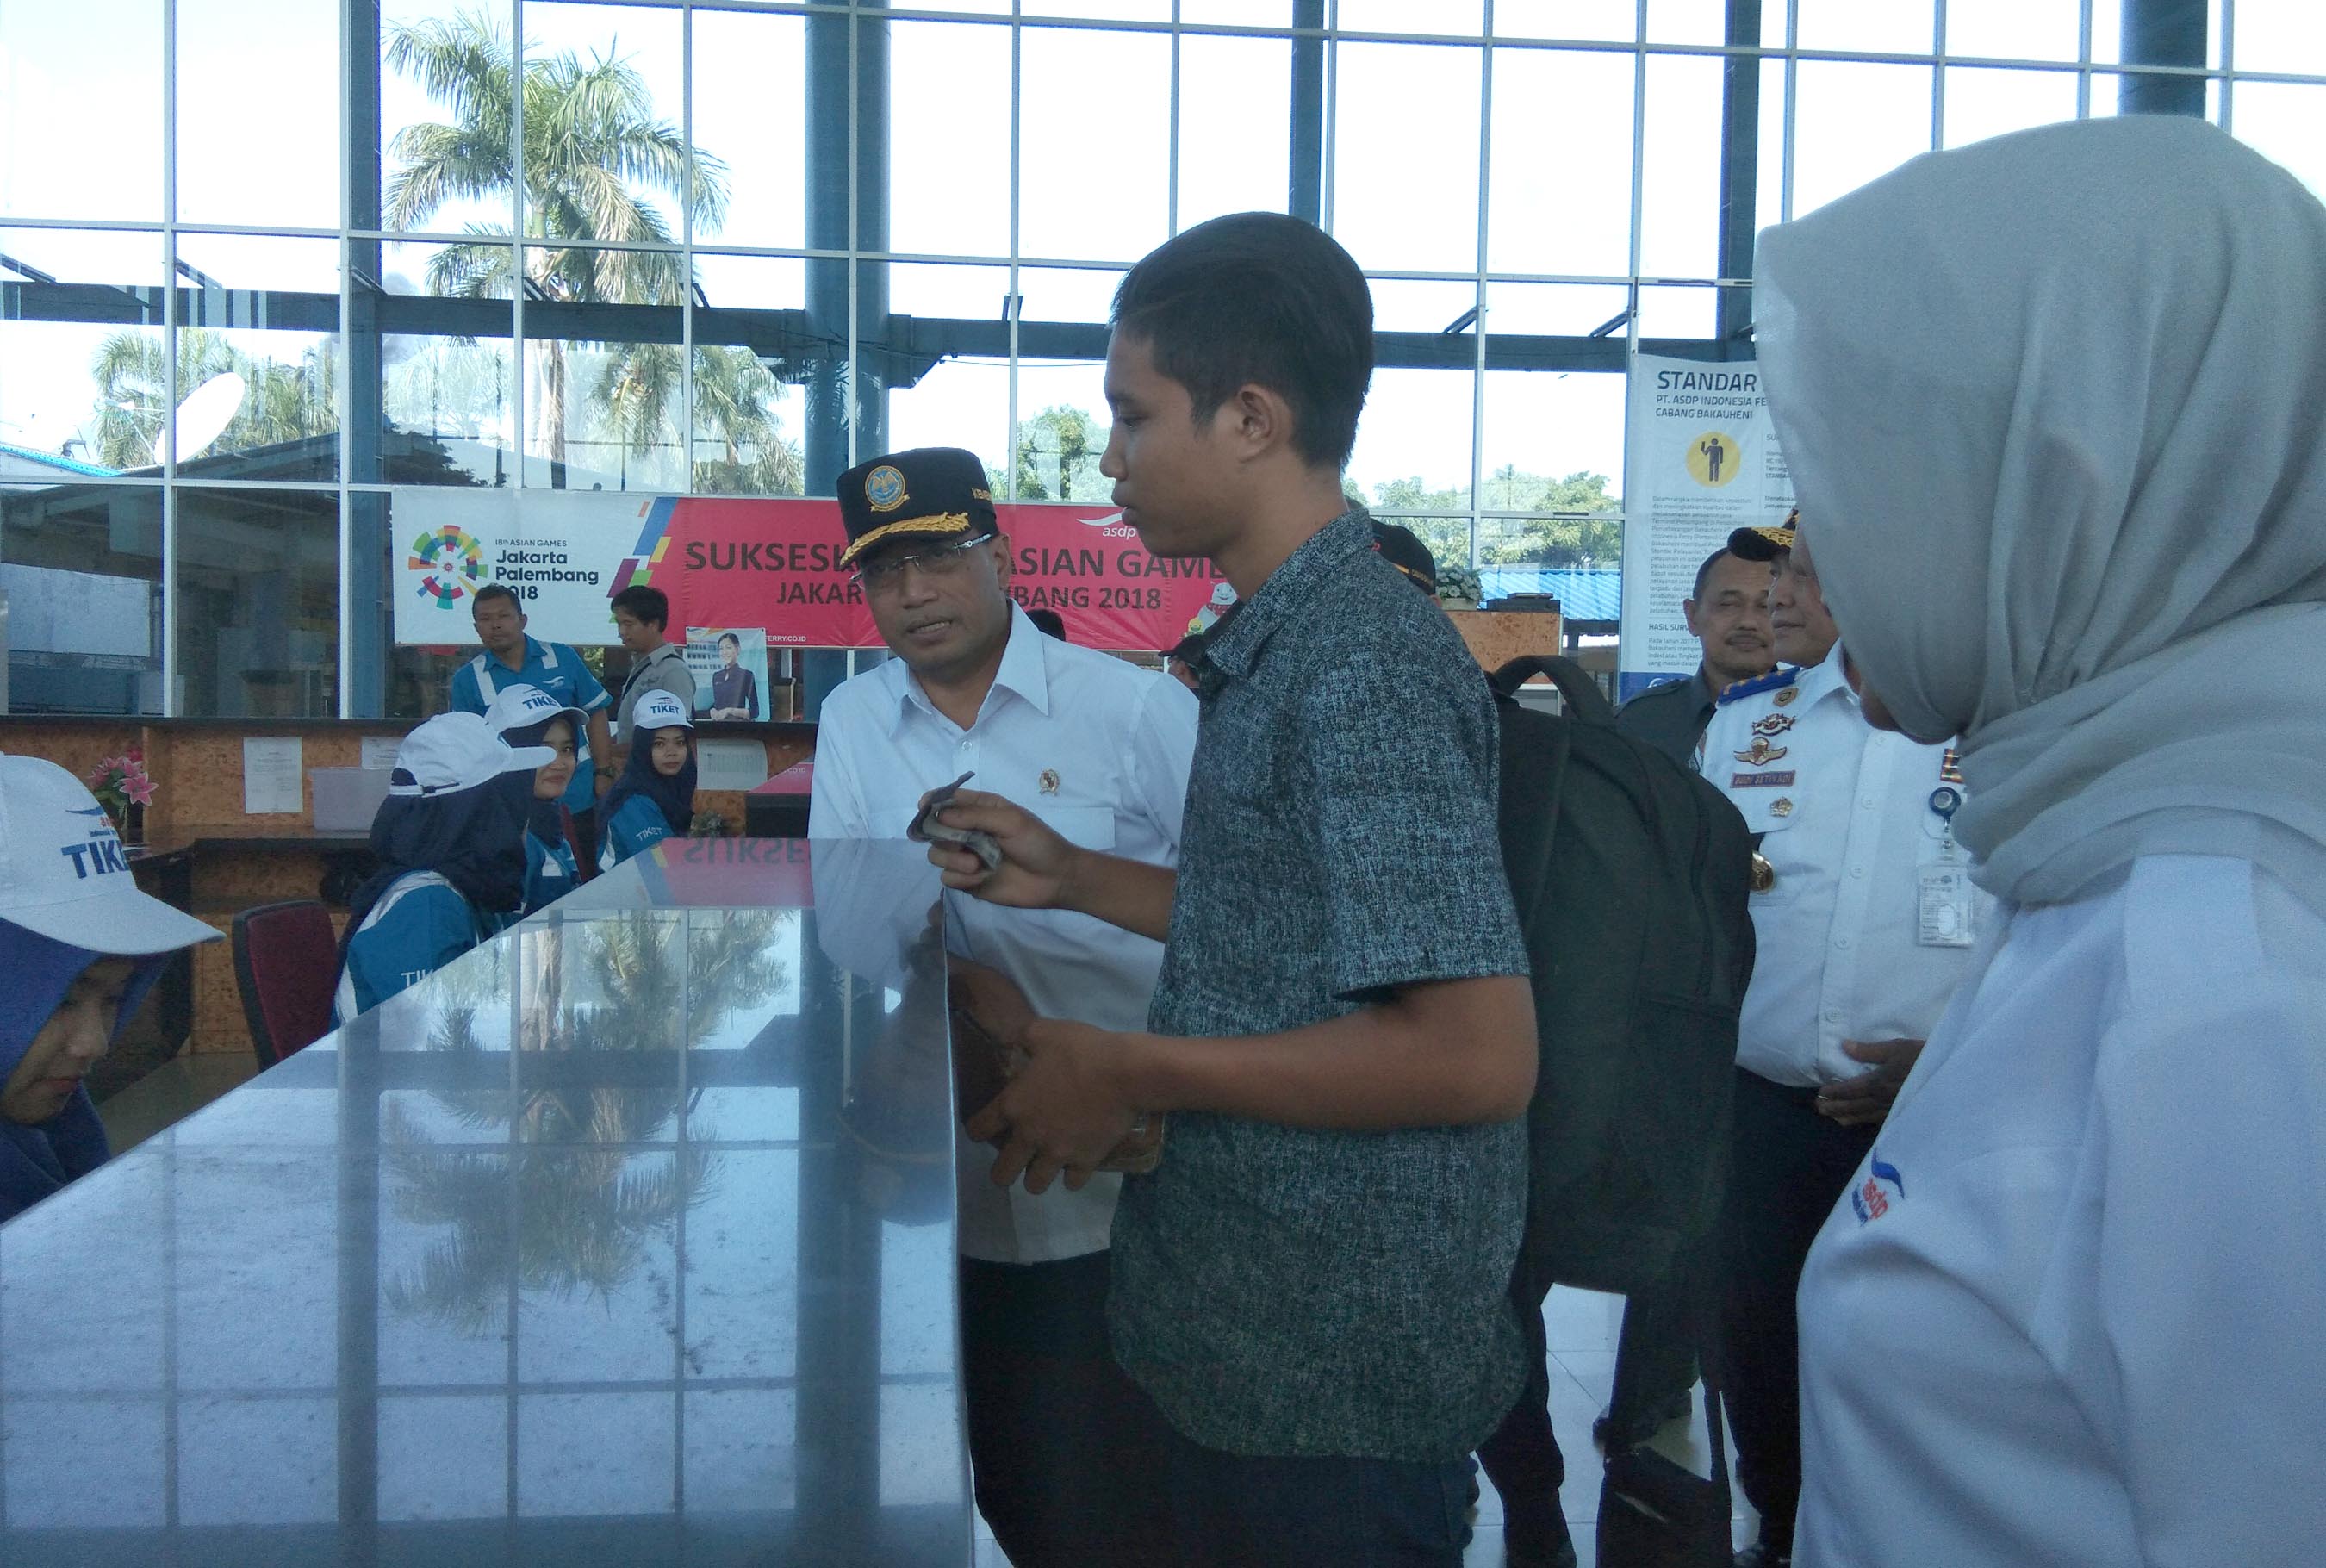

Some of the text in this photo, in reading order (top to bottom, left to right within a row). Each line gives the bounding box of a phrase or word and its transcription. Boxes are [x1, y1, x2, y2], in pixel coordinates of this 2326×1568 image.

[1657, 370, 1757, 392] STANDAR
[1656, 395, 1670, 404] PT.
[1673, 395, 1699, 405] ASDP
[1701, 396, 1752, 407] INDONESIA
[1656, 408, 1753, 420] CABANG BAKAUHENI
[1102, 526, 1136, 539] asdp
[496, 550, 568, 564] Jakarta
[495, 566, 599, 585] Palembang
[1007, 586, 1090, 608] BANG
[1098, 588, 1161, 610] 2018
[650, 705, 679, 714] TIKET
[635, 826, 662, 842] TIKET
